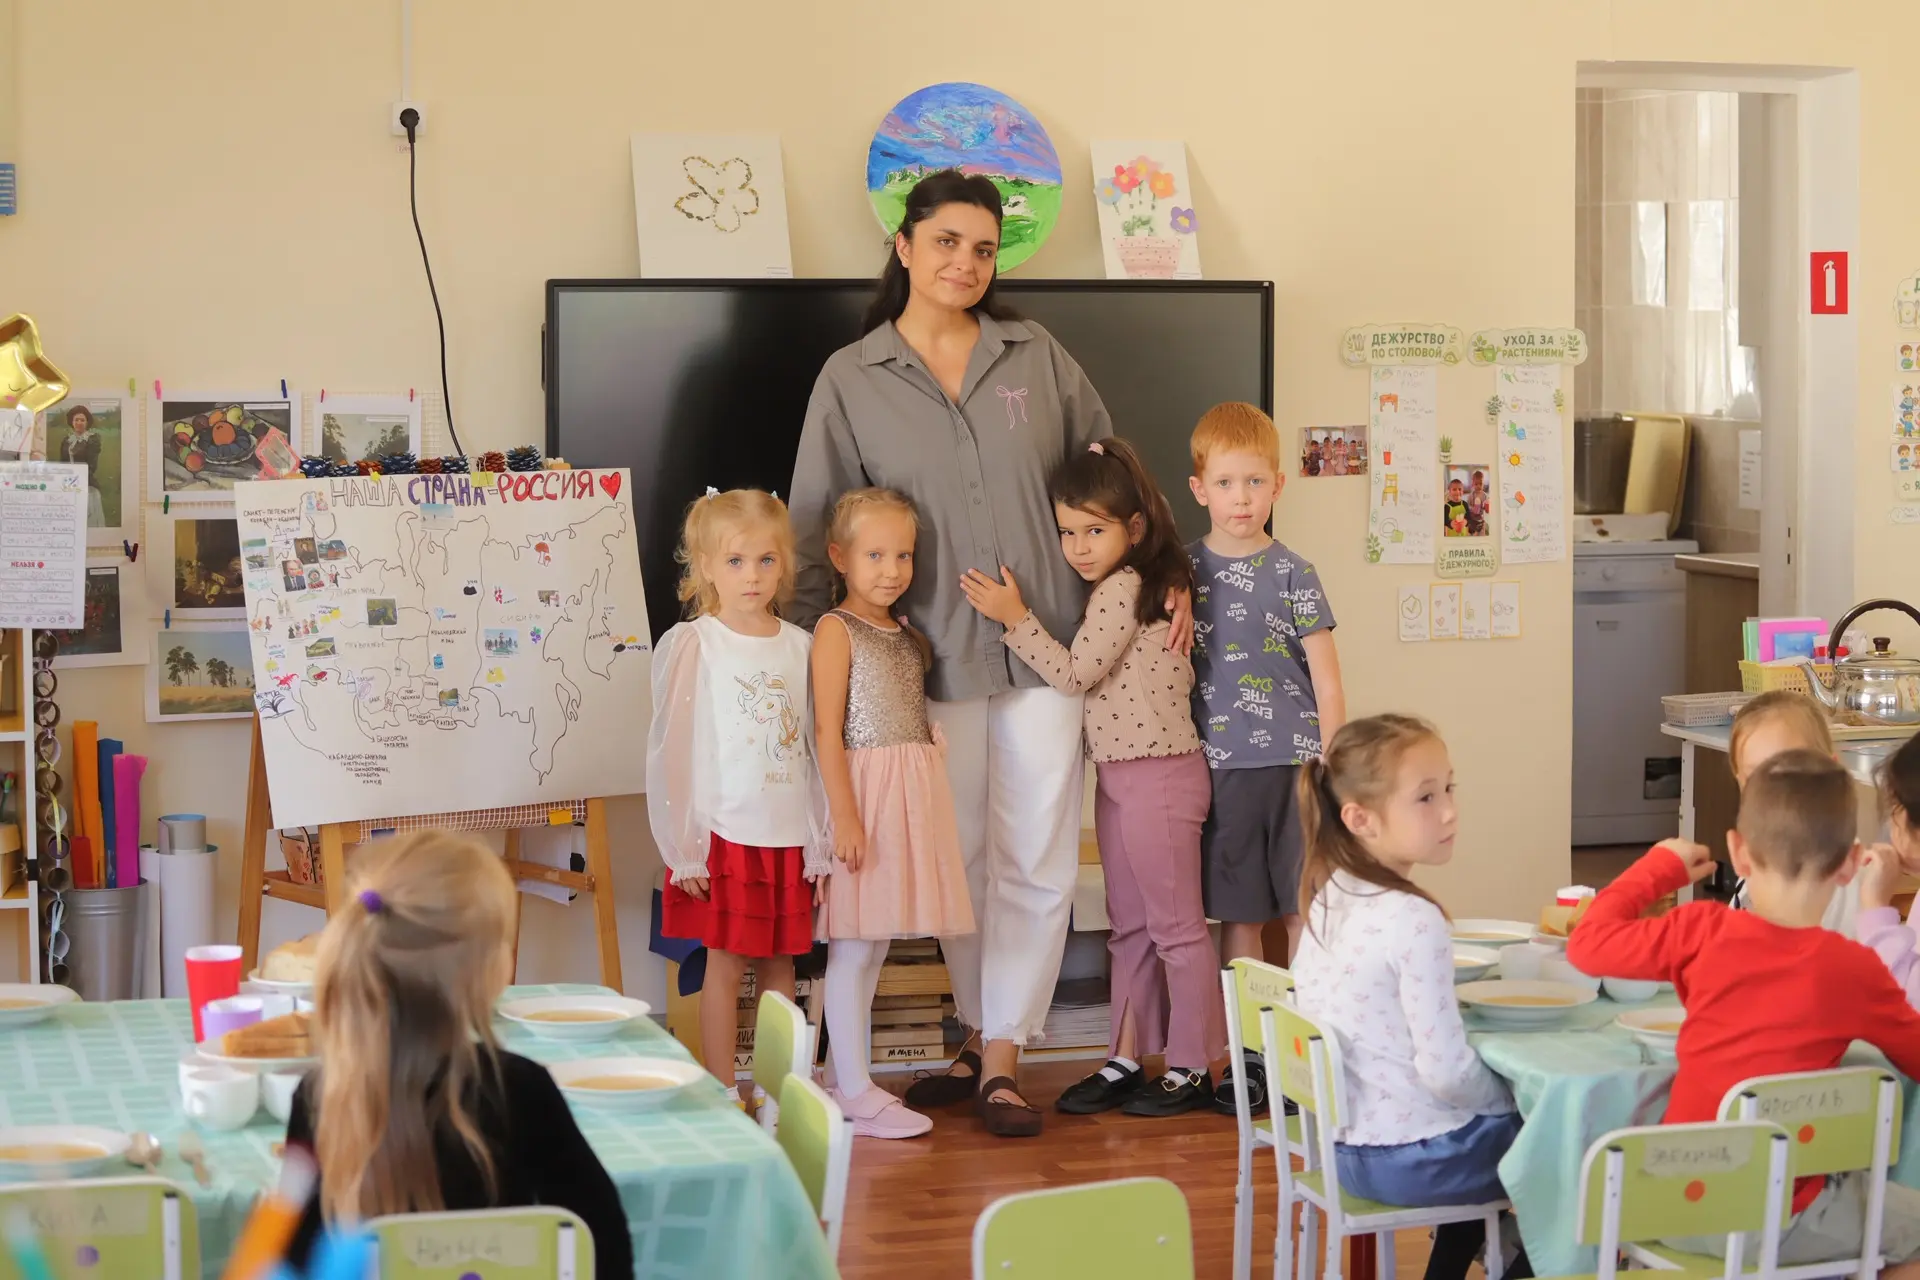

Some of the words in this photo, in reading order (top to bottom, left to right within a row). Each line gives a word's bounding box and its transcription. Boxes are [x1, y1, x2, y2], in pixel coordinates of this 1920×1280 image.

[1371, 332, 1445, 347] ДЕЖУРСТВО
[1503, 334, 1535, 347] УХОД
[1540, 335, 1554, 346] ЗА
[1371, 348, 1386, 359] ПО
[1388, 346, 1442, 359] СТОЛОВОЙ
[1502, 347, 1565, 358] РАСТЕНИЯМИ
[329, 476, 403, 508] НАША
[407, 474, 487, 507] СТРАНА
[497, 470, 595, 504] РОССИЯ
[1448, 549, 1486, 558] ПРАВИЛА
[1229, 561, 1255, 577] THE
[1445, 560, 1490, 570] ДЕЖУРНОГО
[1214, 570, 1255, 593] ENJOY
[1226, 608, 1248, 617] RULES
[1292, 601, 1318, 615] THE
[1225, 643, 1240, 651] FUN
[1224, 652, 1249, 662] EXTRA
[1237, 674, 1273, 693] DAY
[1240, 687, 1270, 704] THE
[1233, 700, 1273, 720] ENJOY
[1208, 715, 1230, 725] EXTRA
[1249, 735, 1272, 744] RULES
[1253, 729, 1268, 737] HERE
[1293, 733, 1323, 752] ENJO
[764, 772, 793, 784] MAGICAL
[1759, 1088, 1844, 1117] ЯРОСЛАВ
